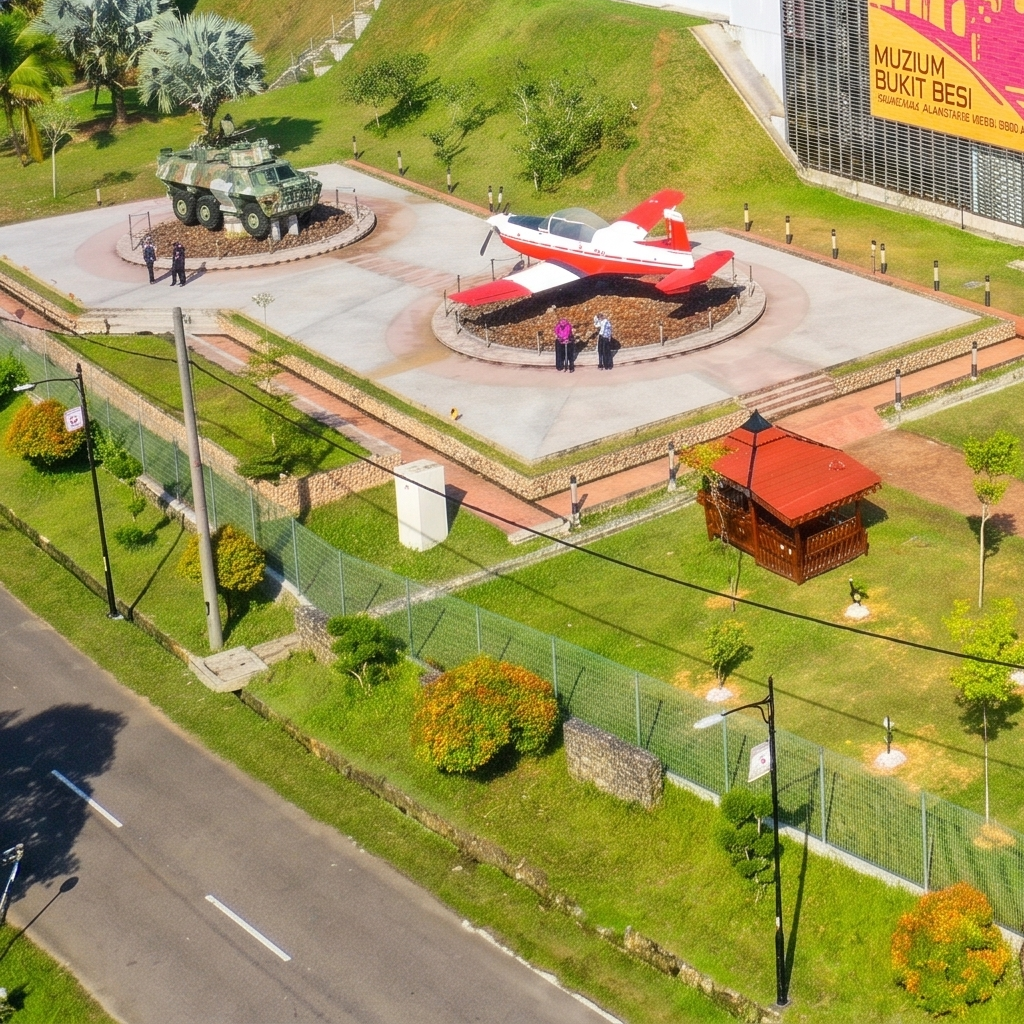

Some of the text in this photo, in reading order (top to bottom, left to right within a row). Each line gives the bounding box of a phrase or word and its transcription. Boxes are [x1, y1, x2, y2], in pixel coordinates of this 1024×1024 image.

[875, 44, 944, 79] MUZIUM
[875, 69, 926, 98] BUKIT
[932, 80, 971, 109] BESI
